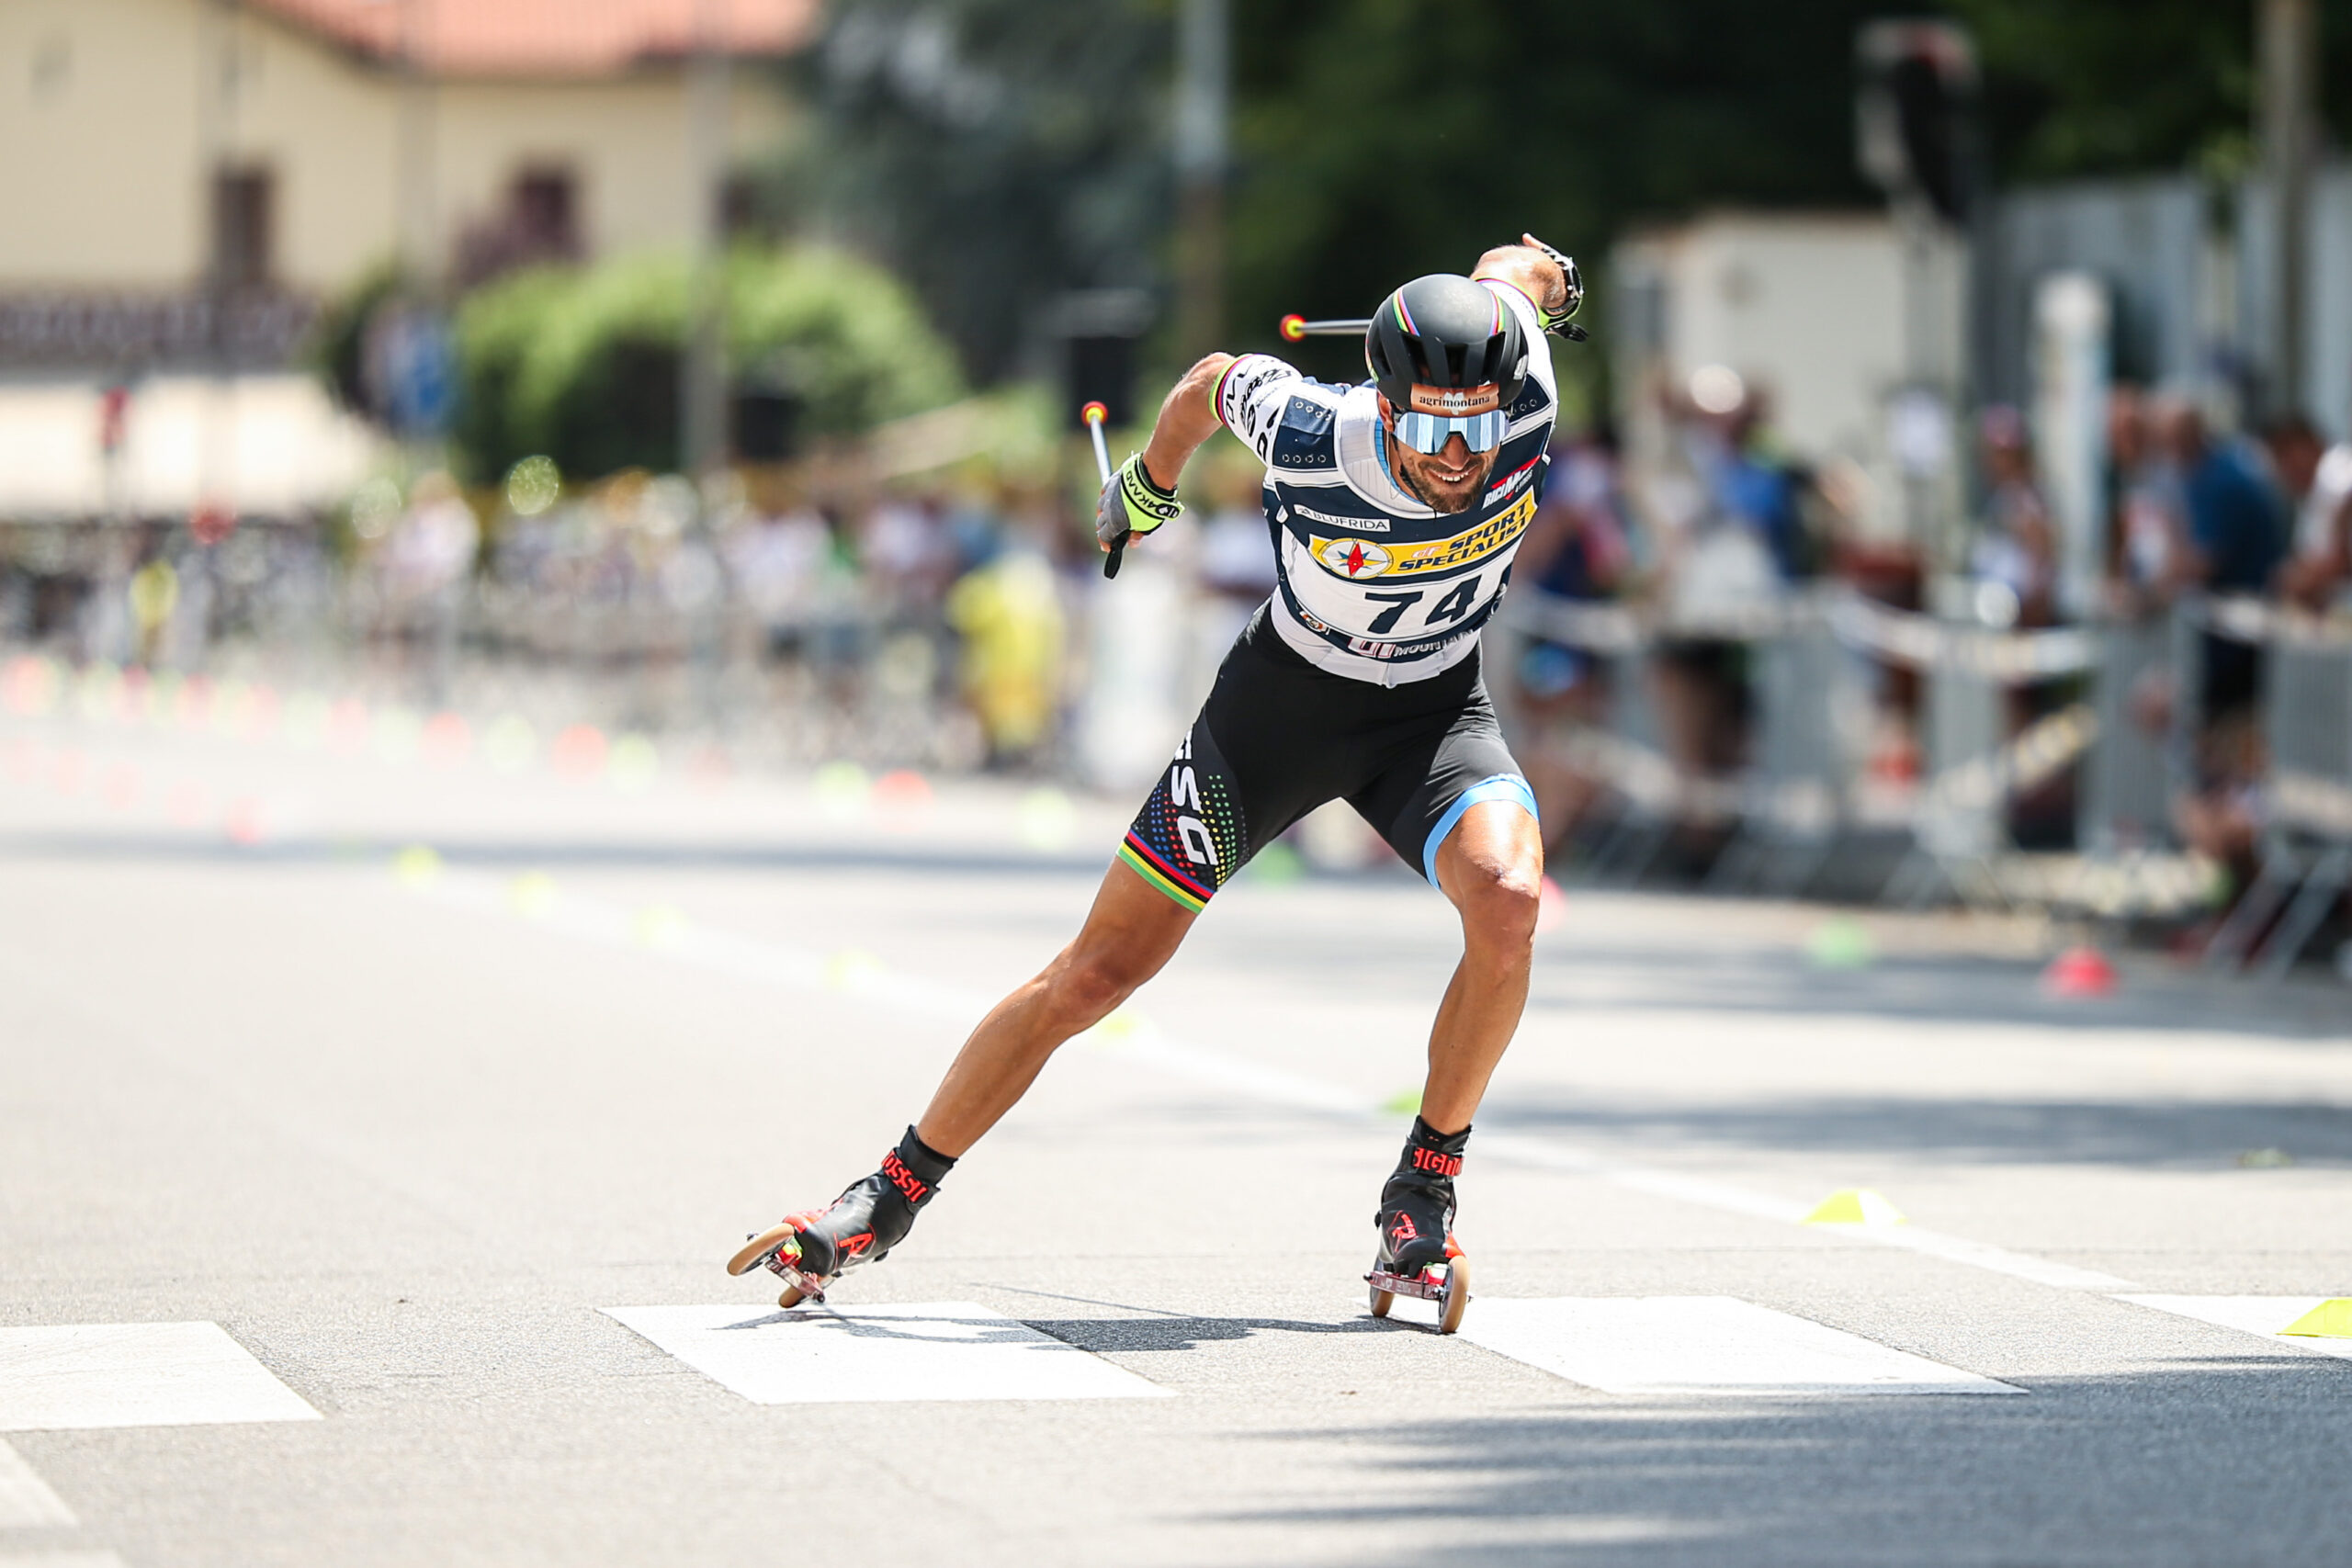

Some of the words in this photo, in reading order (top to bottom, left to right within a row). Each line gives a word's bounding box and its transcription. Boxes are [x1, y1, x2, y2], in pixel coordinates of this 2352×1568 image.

[1419, 395, 1490, 408] agrimontana
[1397, 512, 1530, 571] SPECIALIST
[1449, 498, 1529, 553] SPORT
[1364, 573, 1483, 635] 74
[881, 1149, 929, 1203] OSSI
